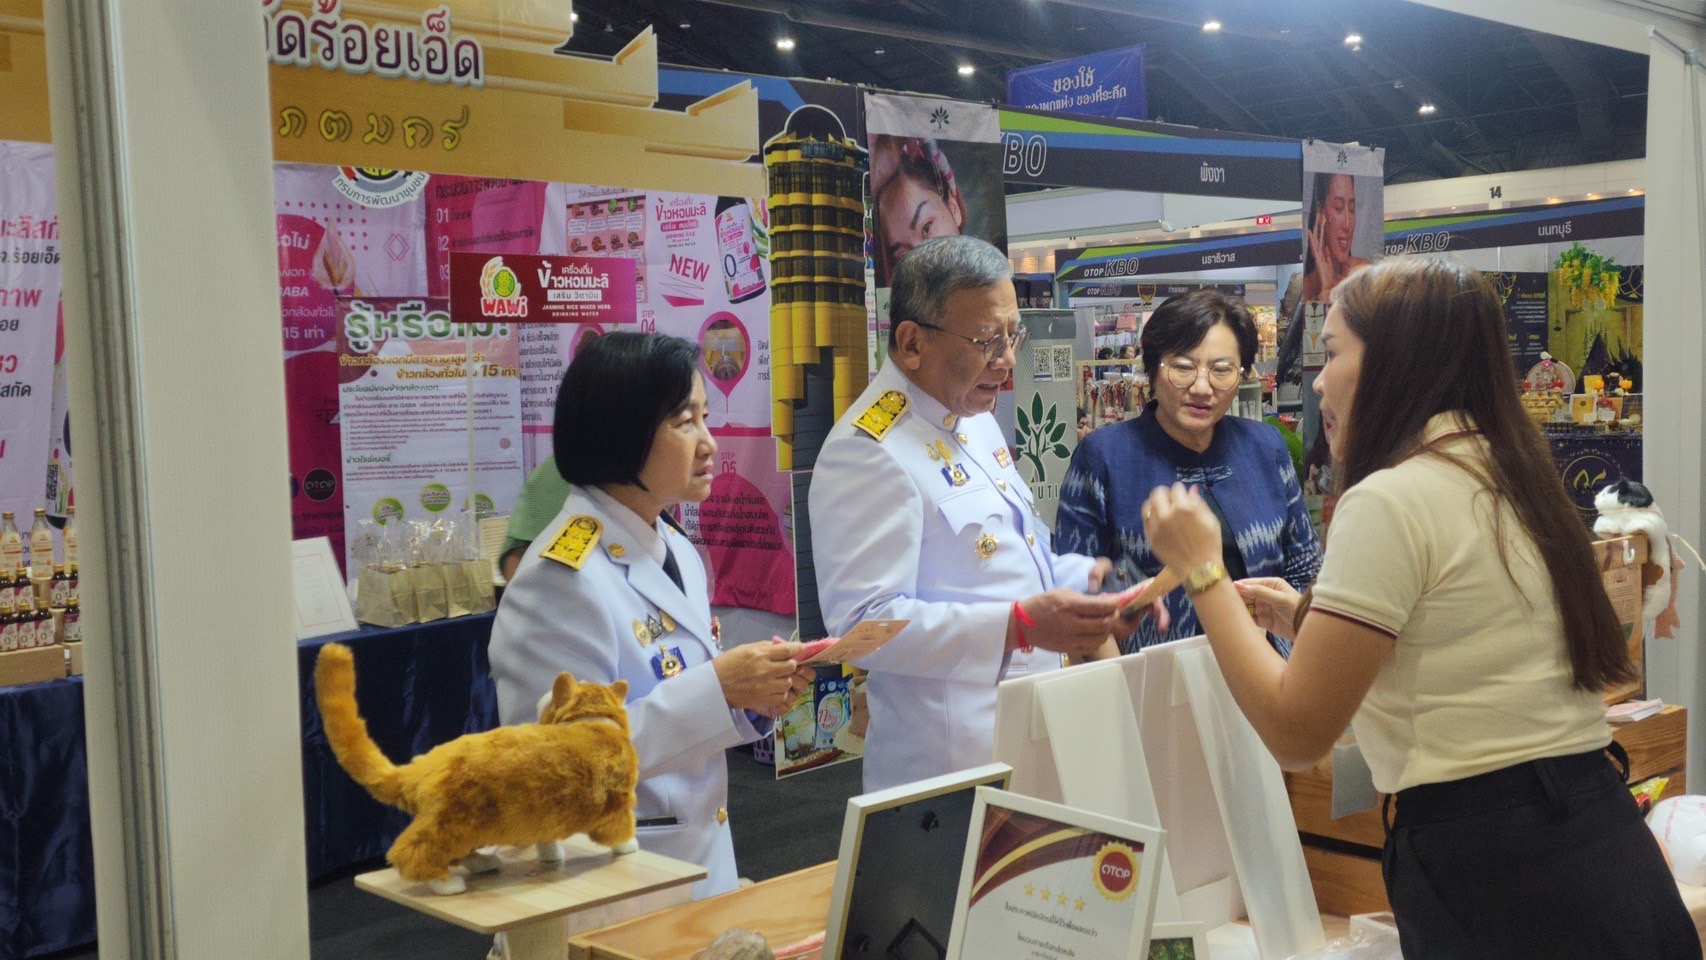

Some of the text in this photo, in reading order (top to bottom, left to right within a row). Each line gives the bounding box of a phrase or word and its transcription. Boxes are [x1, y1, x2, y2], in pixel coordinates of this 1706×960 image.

[1052, 65, 1096, 93] ของใช้
[1076, 85, 1127, 106] ของที่ระลึก
[1000, 132, 1047, 177] BO
[1200, 161, 1225, 183] พังงา
[335, 172, 426, 206] กรมการพัฒนาชุมชน
[1489, 186, 1502, 199] 14
[436, 207, 449, 223] 01
[656, 197, 707, 221] ข้าวหอมมะลิ
[1537, 221, 1572, 238] นนทบุรี
[1405, 231, 1451, 254] KBO
[1202, 252, 1236, 265] นราธิวาส
[537, 260, 609, 289] ข้าวหอมมะลิ
[561, 262, 593, 275] เครื่องดื่ม
[669, 253, 710, 282] NEW
[1084, 257, 1140, 278] OTOP KBO
[641, 310, 655, 318] STEP
[284, 324, 325, 339] 15 เท่า
[641, 318, 656, 334] 04
[481, 364, 498, 377] 15
[720, 452, 735, 460] STEP
[1101, 863, 1131, 879] OTOP
